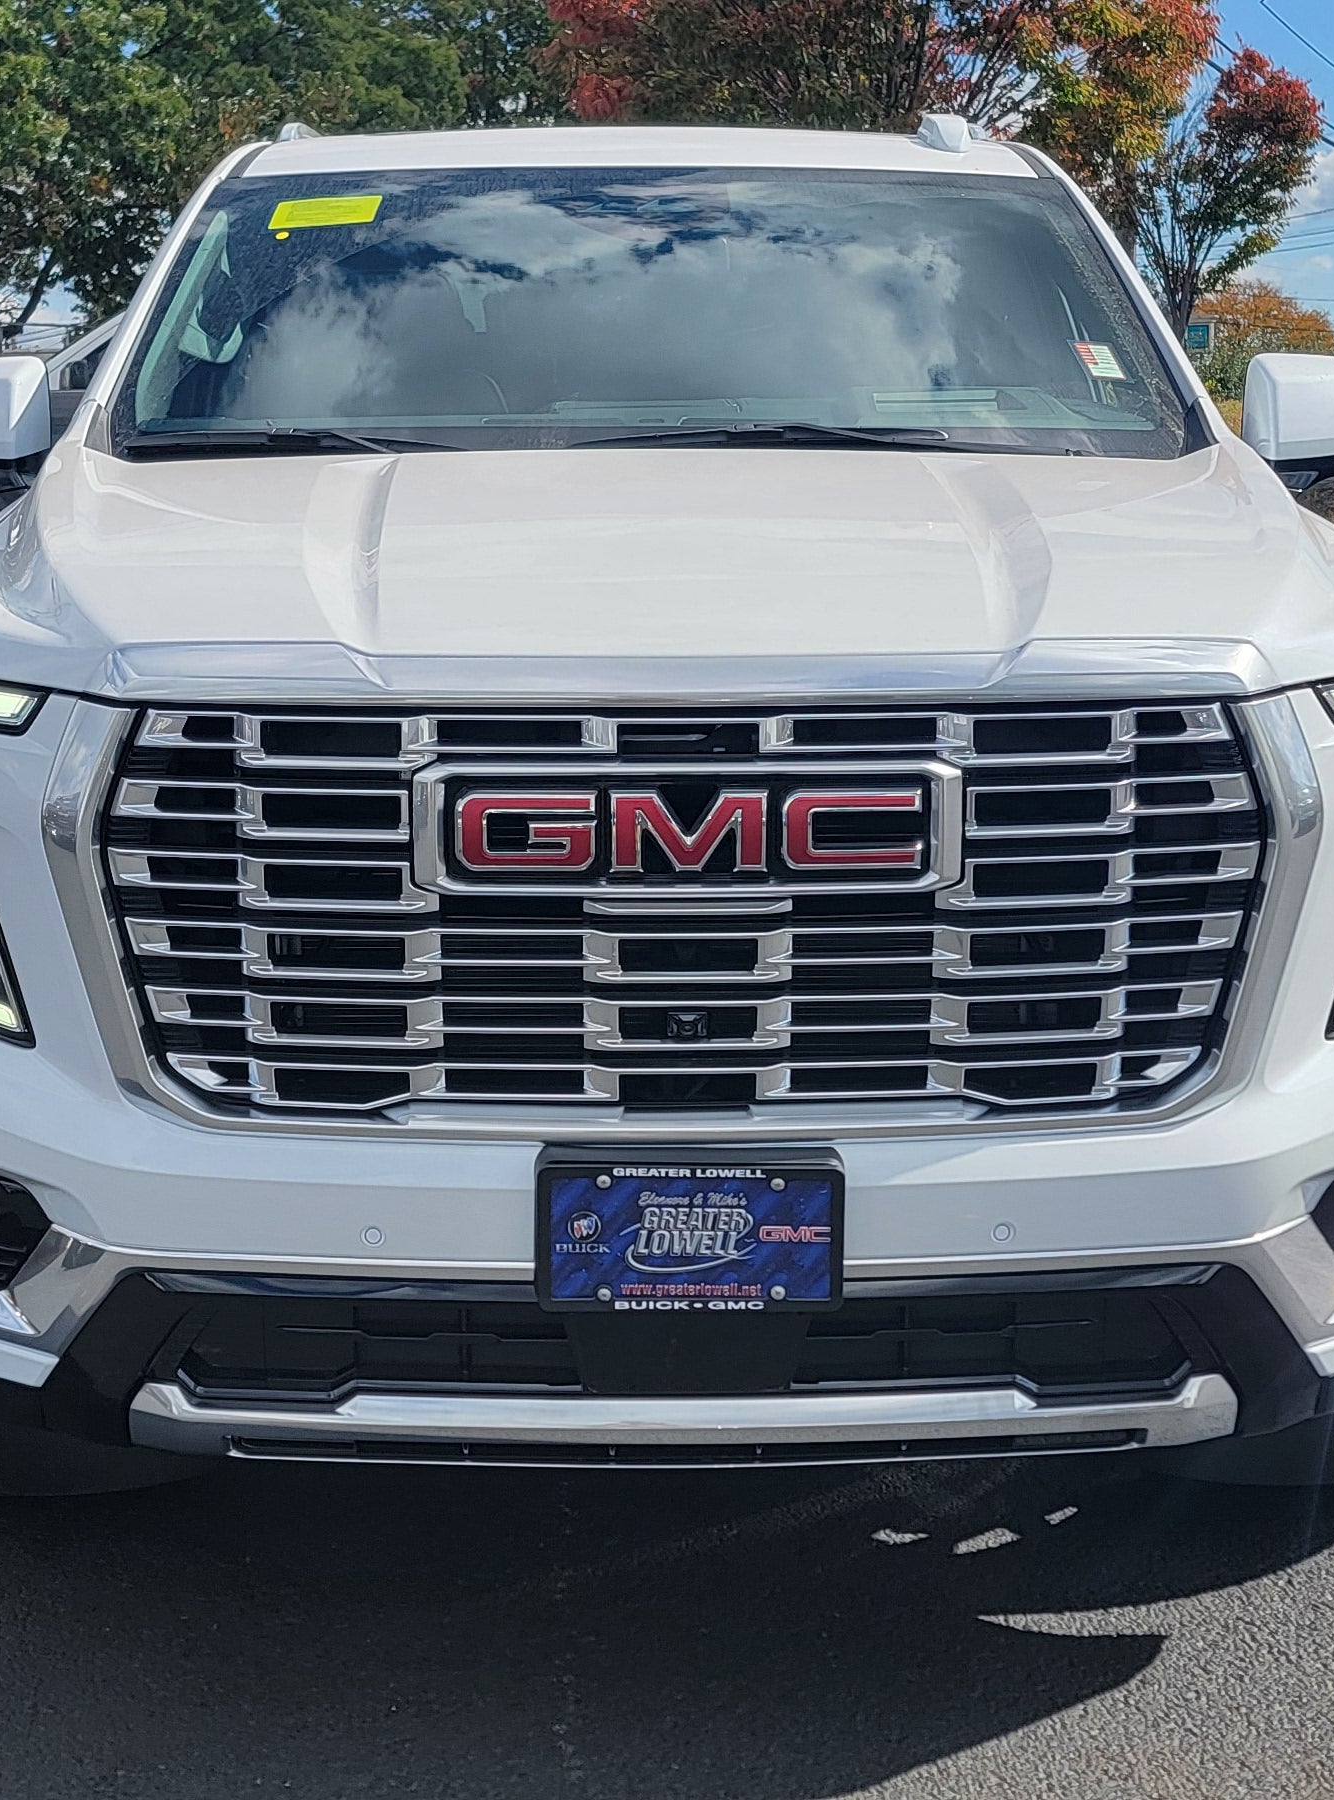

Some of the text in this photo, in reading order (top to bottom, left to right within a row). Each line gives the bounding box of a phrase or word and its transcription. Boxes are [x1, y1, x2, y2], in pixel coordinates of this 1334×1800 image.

[455, 787, 923, 873] GMC
[612, 1168, 767, 1179] GREATER LOWELL
[641, 1207, 746, 1231] GREATER
[758, 1225, 831, 1243] GMC
[555, 1243, 611, 1254] BUICK
[634, 1230, 738, 1257] LOWELL
[620, 1283, 762, 1297] www.greaterlowell.net
[614, 1301, 765, 1310] BUICK GMC
